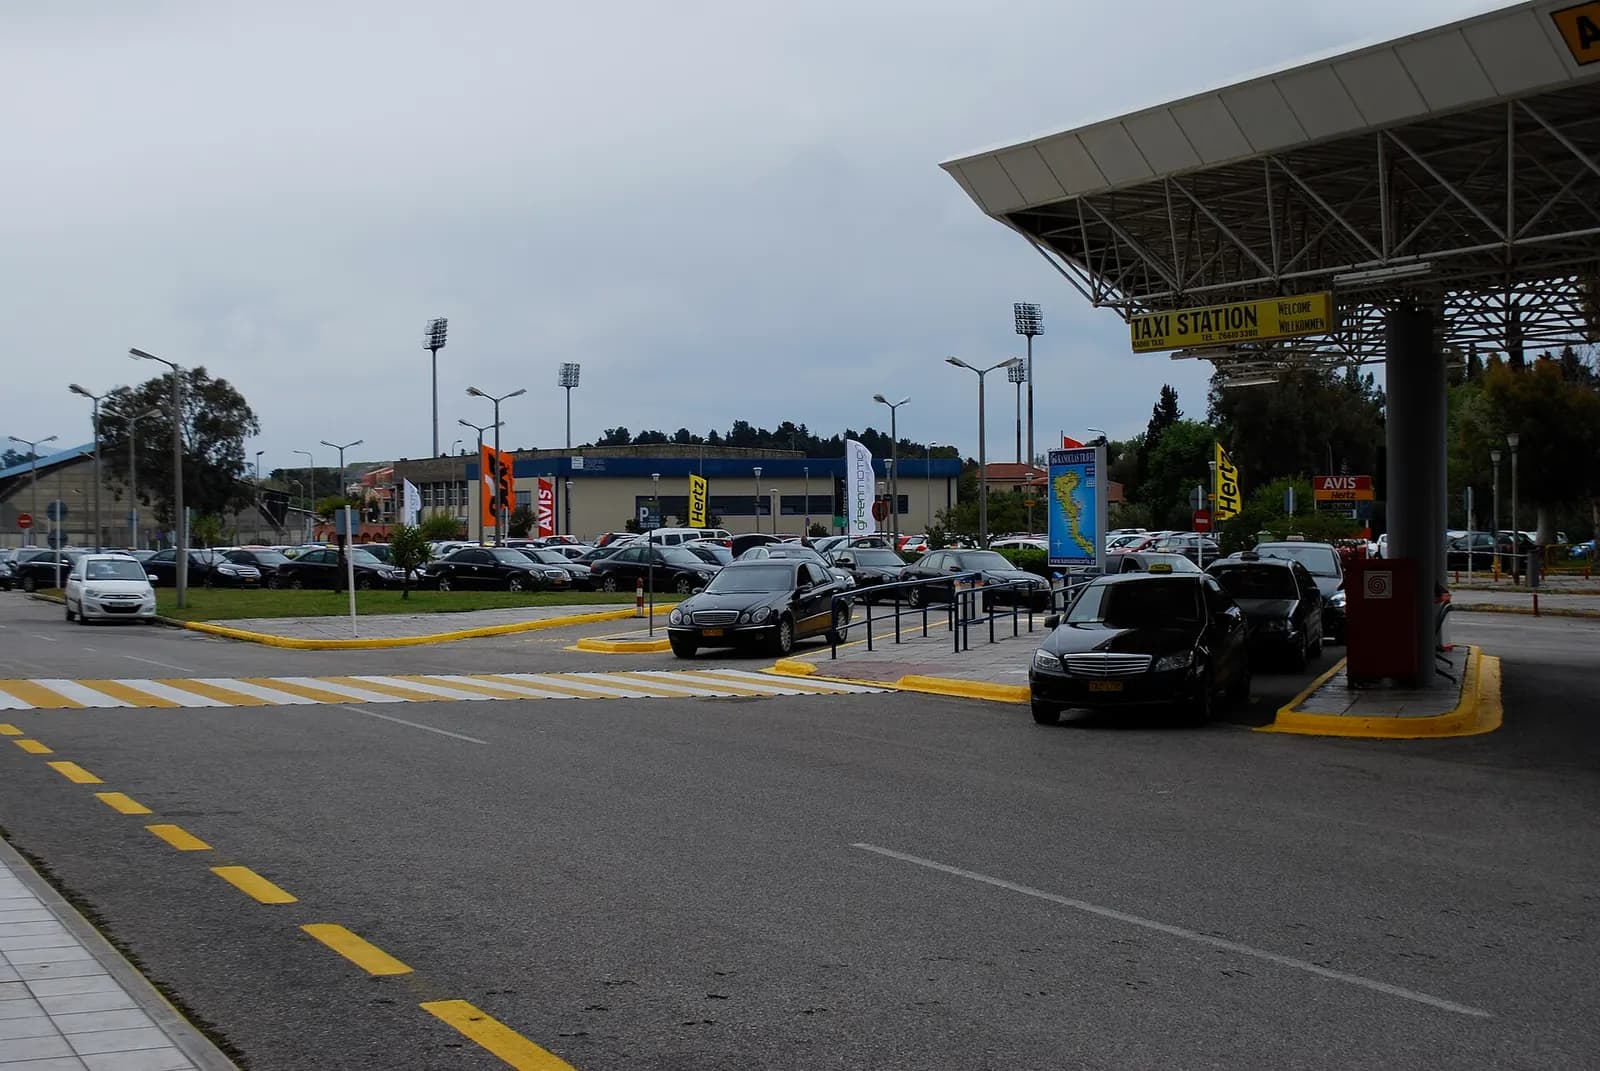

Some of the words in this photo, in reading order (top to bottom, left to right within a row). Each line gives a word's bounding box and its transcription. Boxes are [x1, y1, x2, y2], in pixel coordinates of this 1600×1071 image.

[1277, 301, 1312, 315] WELCOME
[1132, 315, 1170, 339] TAXI
[1177, 304, 1257, 335] STATION
[1278, 318, 1325, 333] WILLKOMMEN
[1323, 477, 1356, 489] AVIS
[691, 480, 705, 522] Hertz
[1331, 491, 1356, 499] Hertz
[538, 489, 552, 531] AVIS
[639, 507, 649, 521] P
